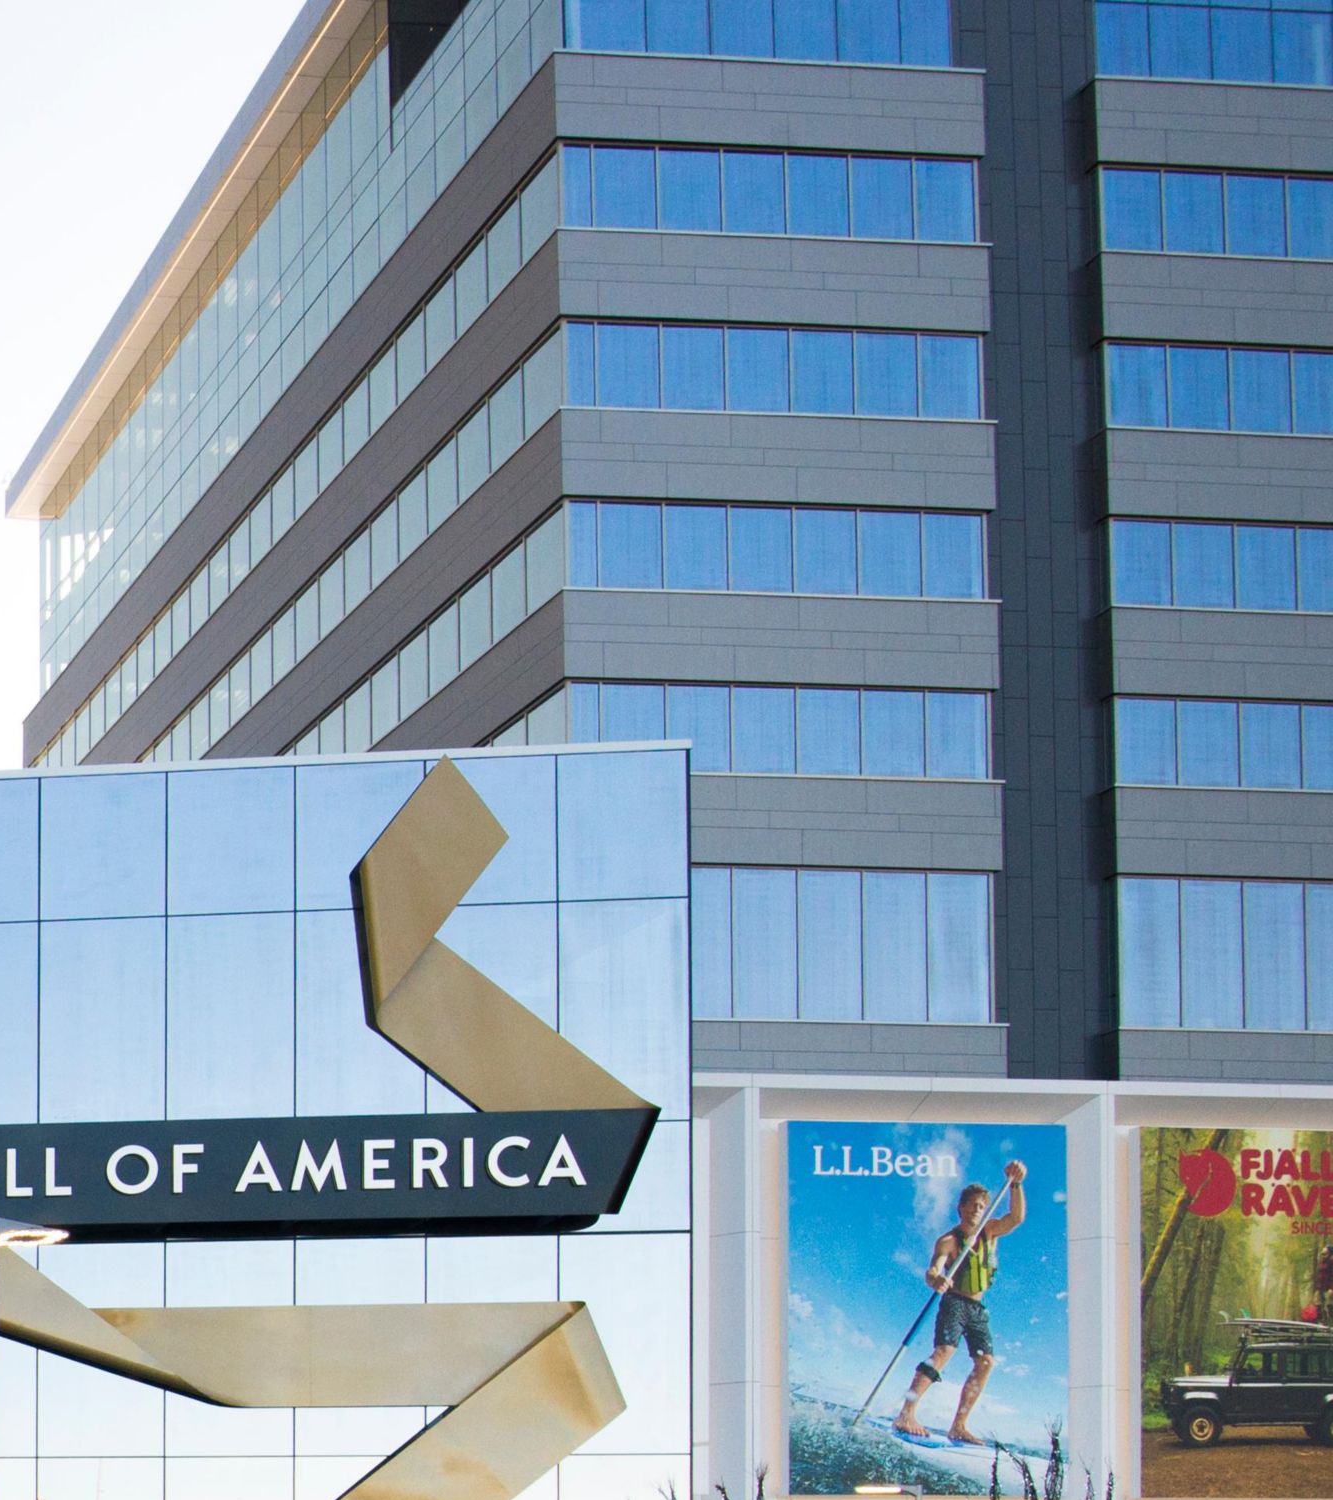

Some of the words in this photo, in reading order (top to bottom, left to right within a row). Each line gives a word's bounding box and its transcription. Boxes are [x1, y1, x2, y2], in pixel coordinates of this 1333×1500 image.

[106, 1144, 205, 1195] OF
[234, 1133, 587, 1193] AMERICA
[813, 1145, 958, 1177] L.L.Bean
